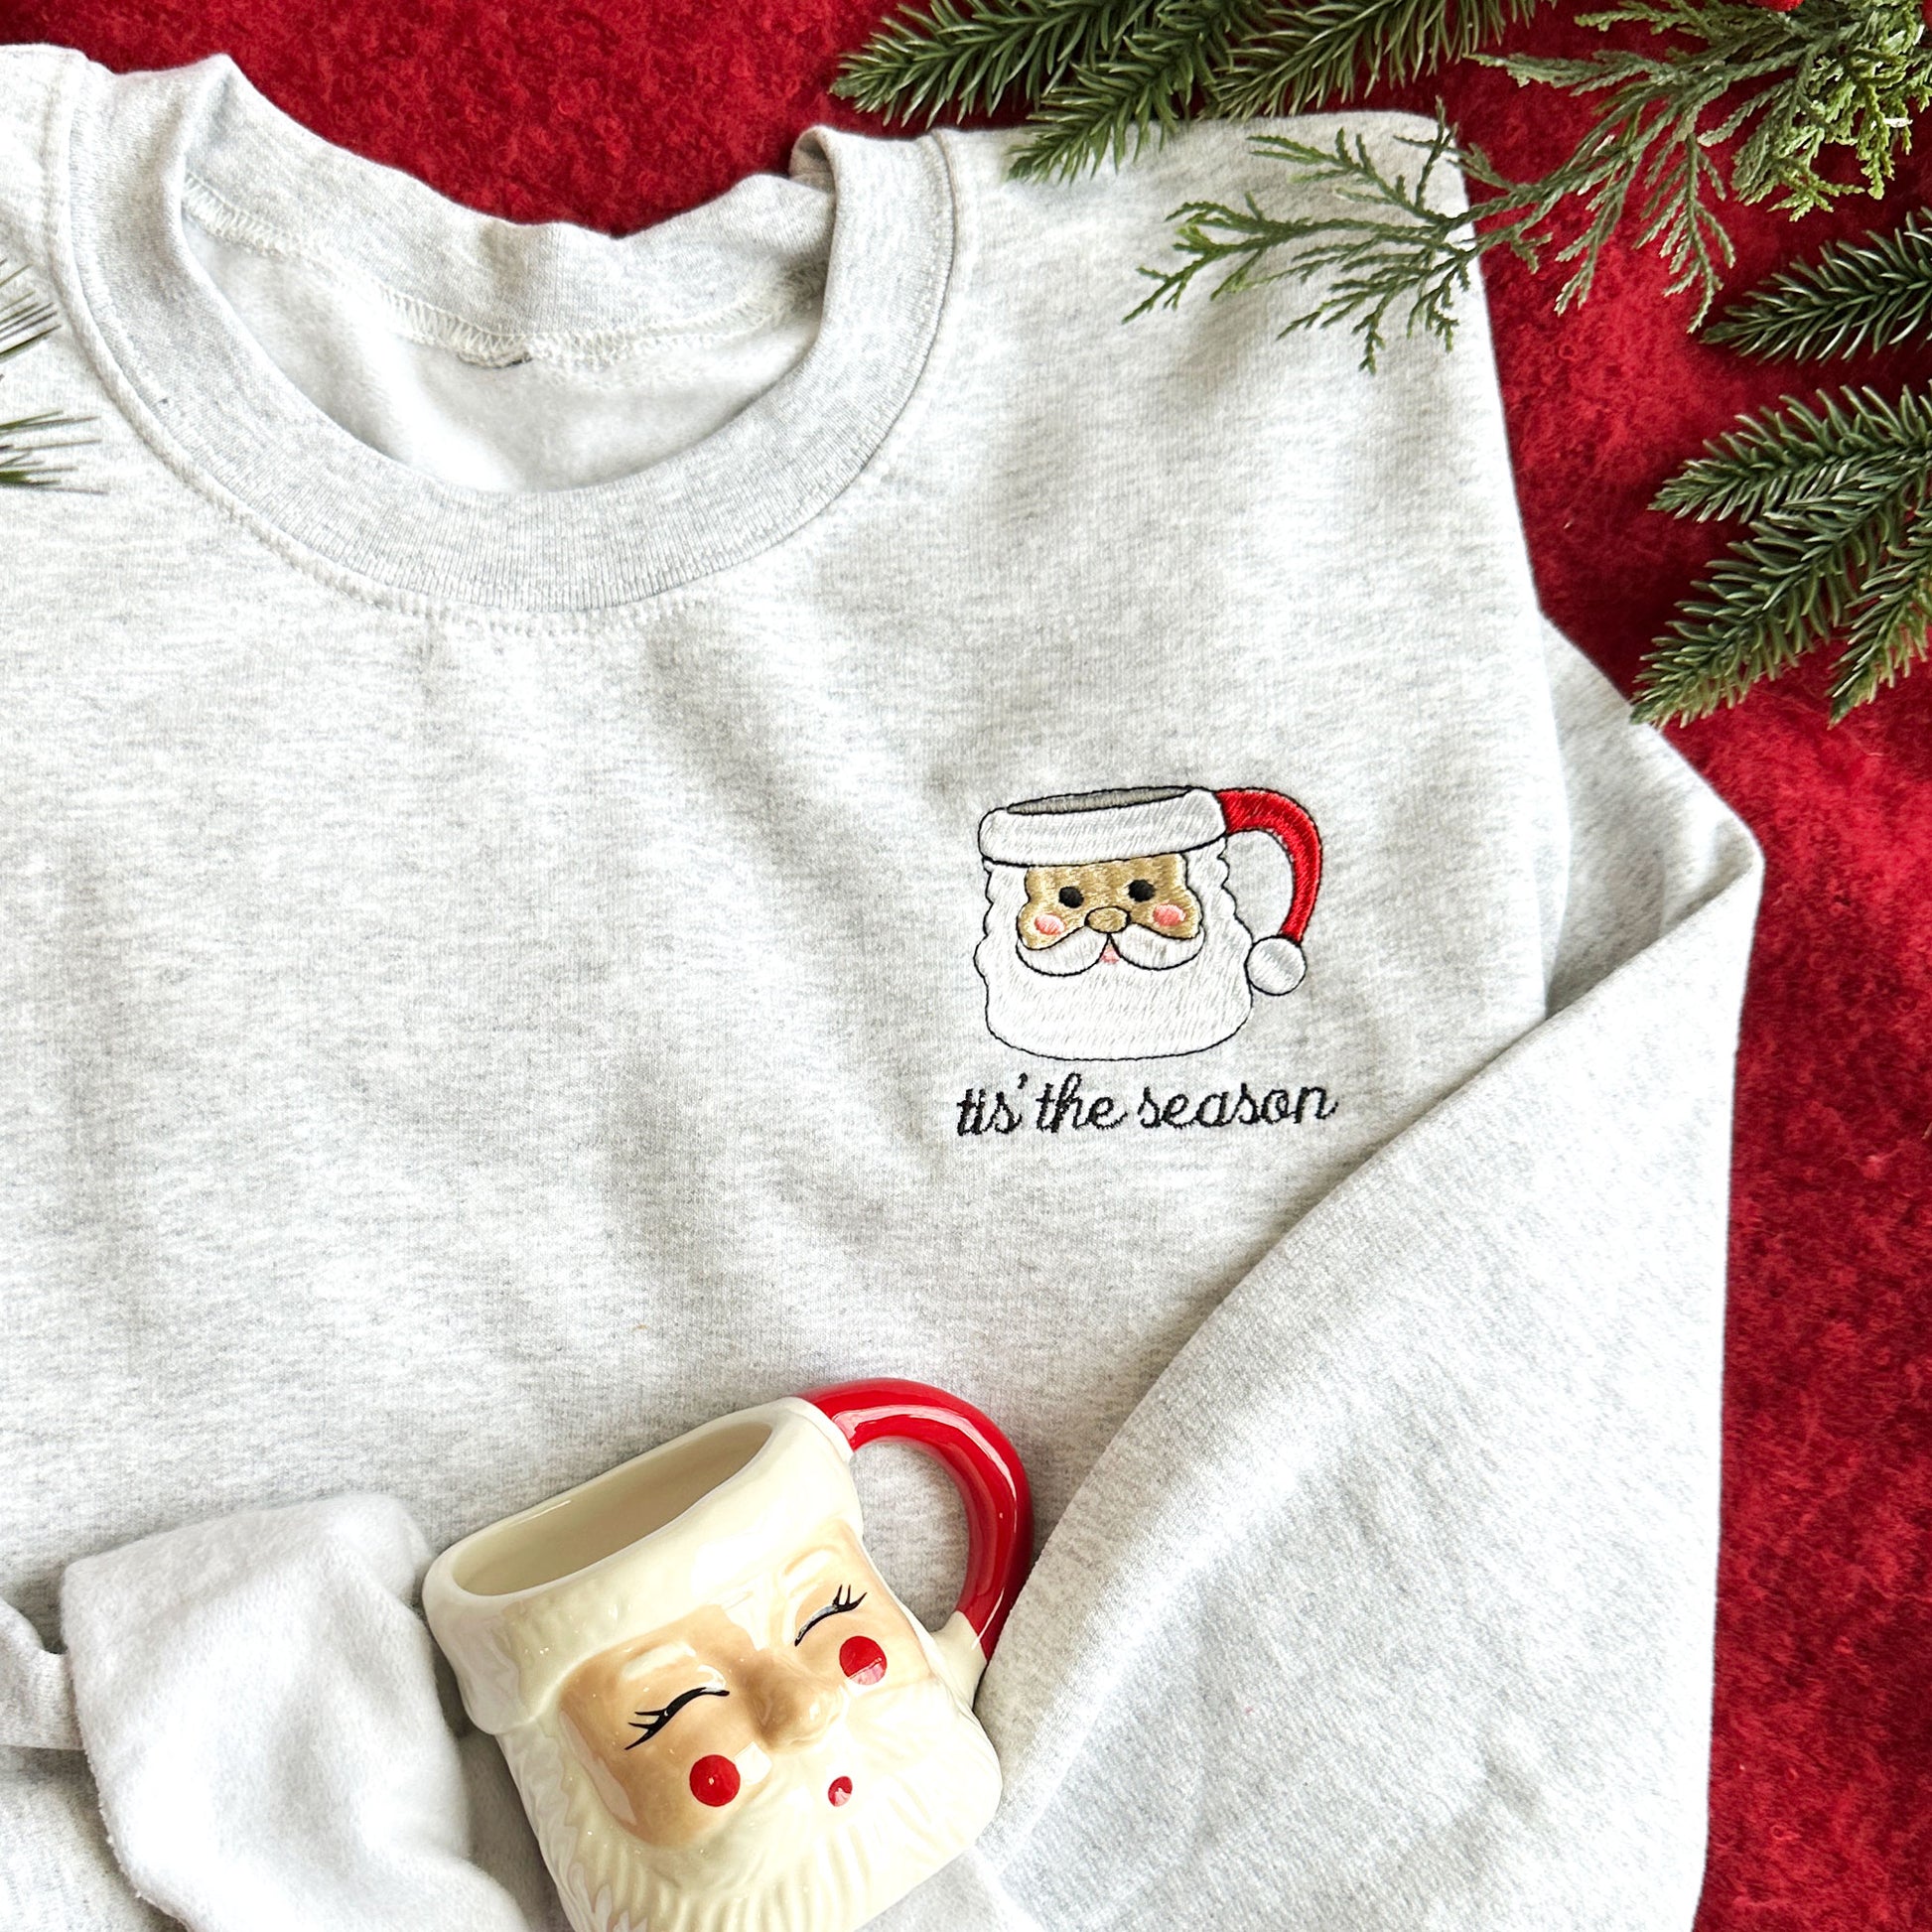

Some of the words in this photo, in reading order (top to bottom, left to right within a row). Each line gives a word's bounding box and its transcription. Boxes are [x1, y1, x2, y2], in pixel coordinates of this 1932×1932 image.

[956, 1072, 1029, 1137] tis'
[1035, 1072, 1129, 1134] the
[1137, 1082, 1339, 1130] season
